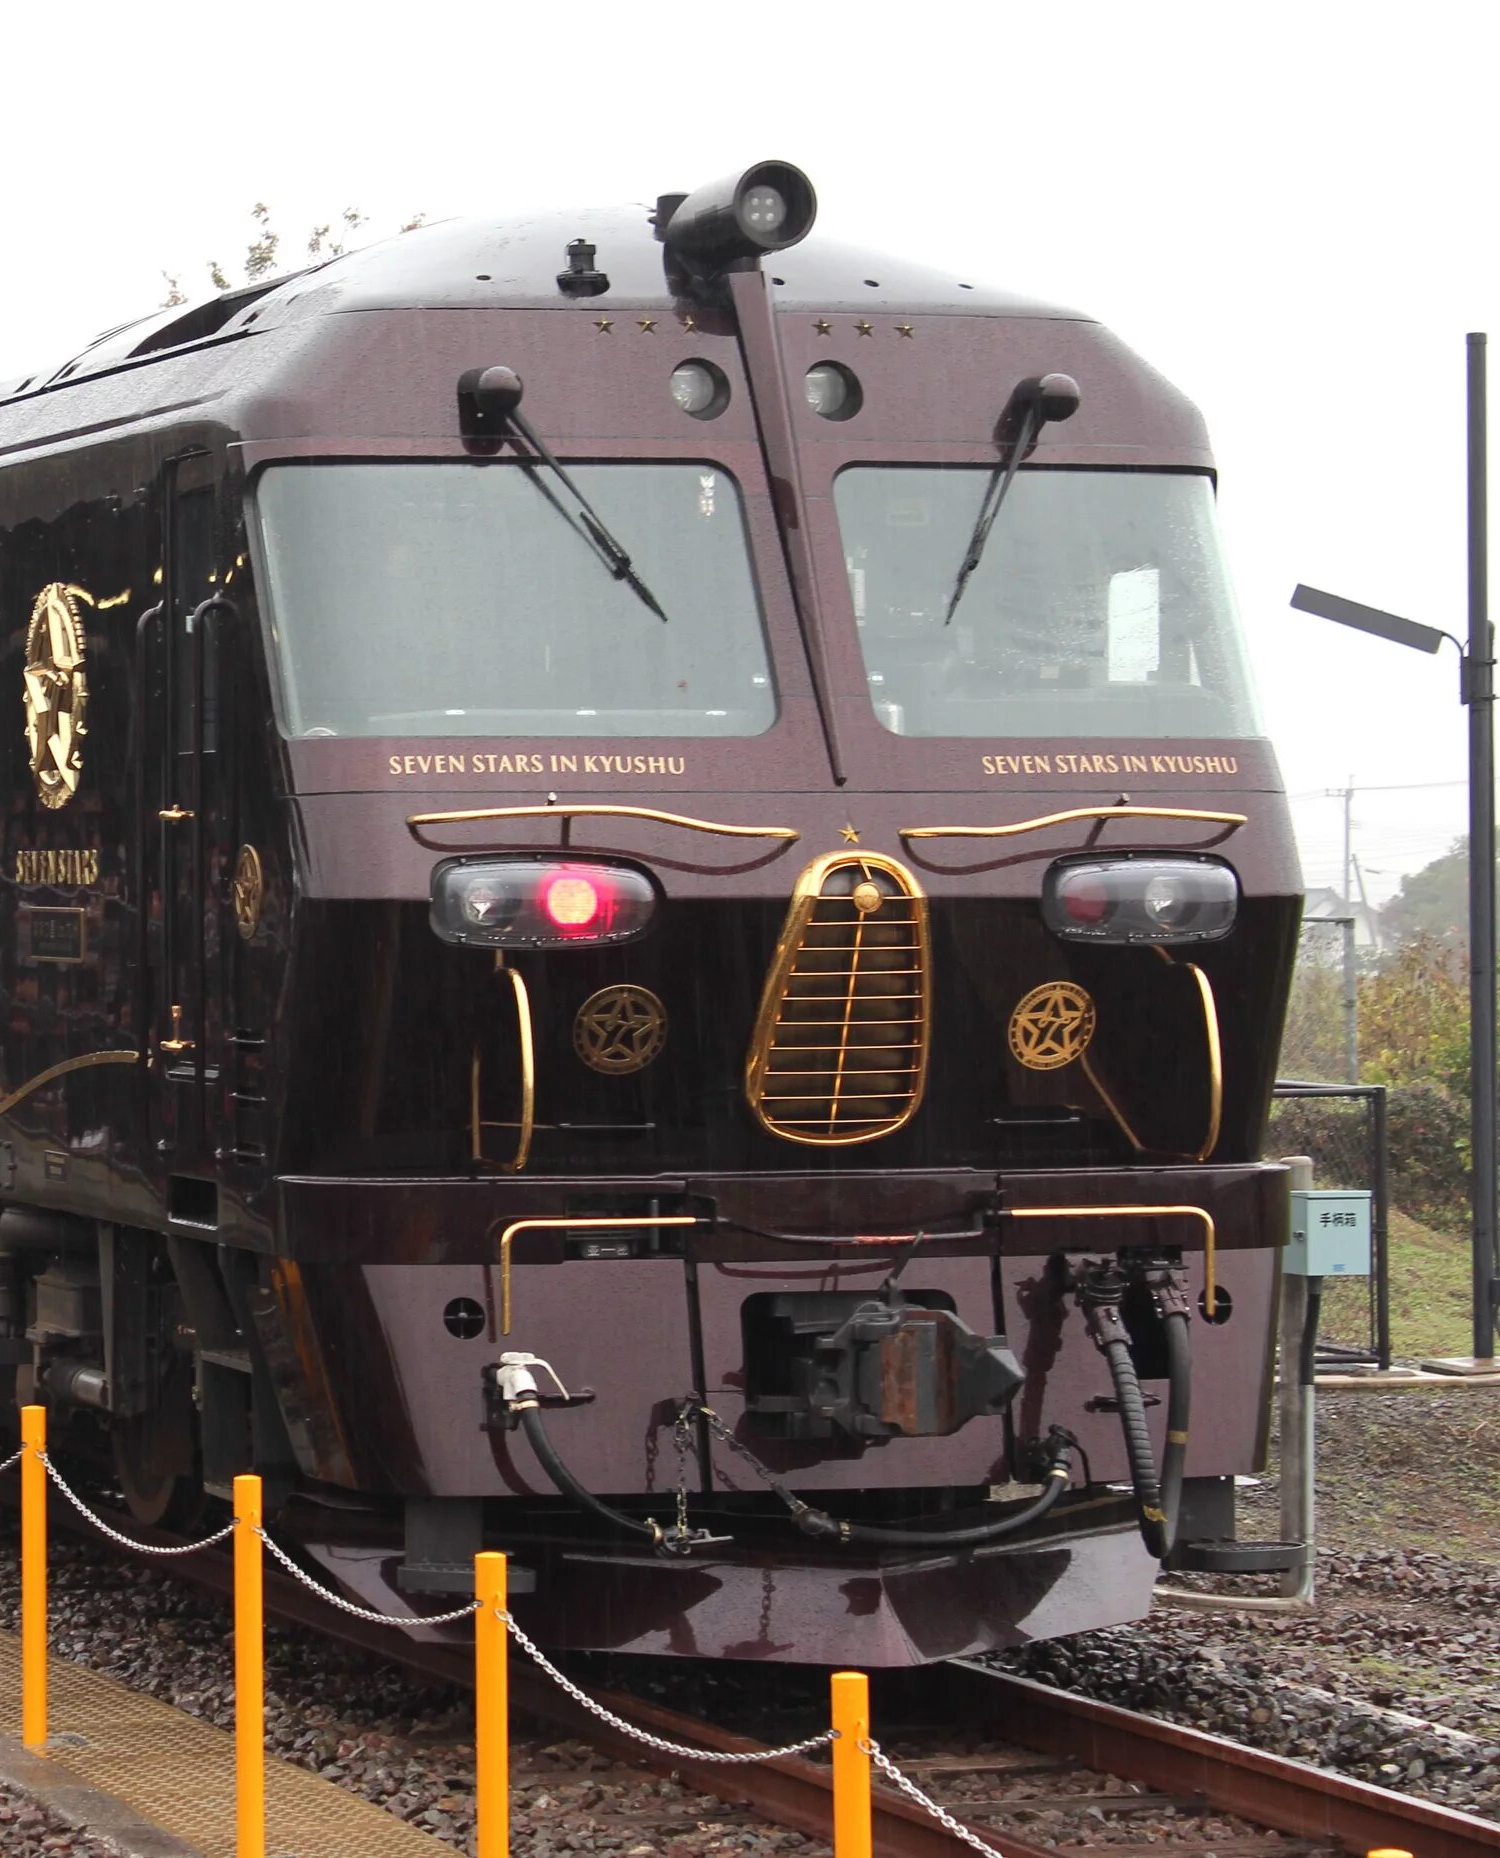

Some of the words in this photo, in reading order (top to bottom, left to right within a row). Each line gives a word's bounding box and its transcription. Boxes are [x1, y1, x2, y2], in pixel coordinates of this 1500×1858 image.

[389, 755, 465, 775] SEVEN
[472, 754, 544, 773] STARS
[550, 755, 578, 773] IN
[584, 755, 686, 775] KYUSHU
[982, 755, 1051, 775] SEVEN
[1054, 755, 1119, 774] STARS
[1122, 755, 1148, 773] IN
[1150, 755, 1239, 775] KYUSHU
